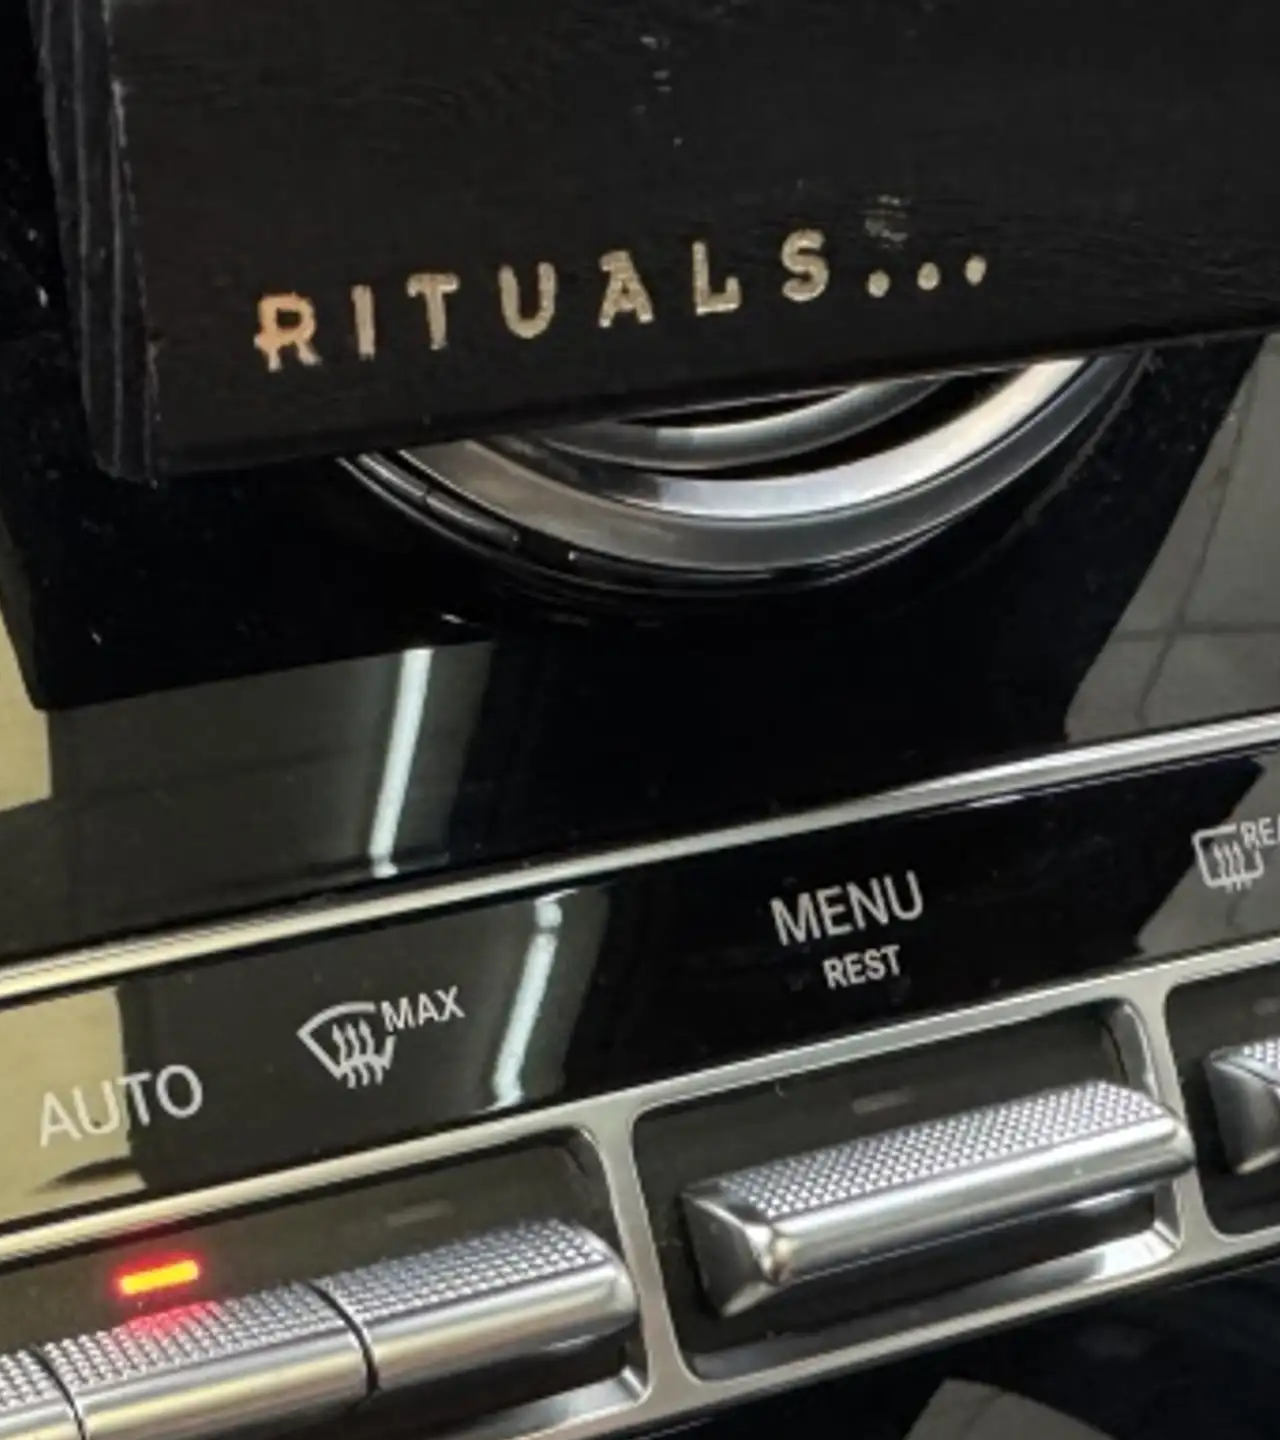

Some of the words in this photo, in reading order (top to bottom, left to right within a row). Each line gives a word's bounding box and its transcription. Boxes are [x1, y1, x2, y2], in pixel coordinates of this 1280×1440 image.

[253, 228, 988, 372] RITUALS...
[769, 870, 925, 947] MENU
[822, 944, 903, 990] REST
[380, 985, 466, 1033] MAX
[39, 1064, 204, 1148] AUTO
